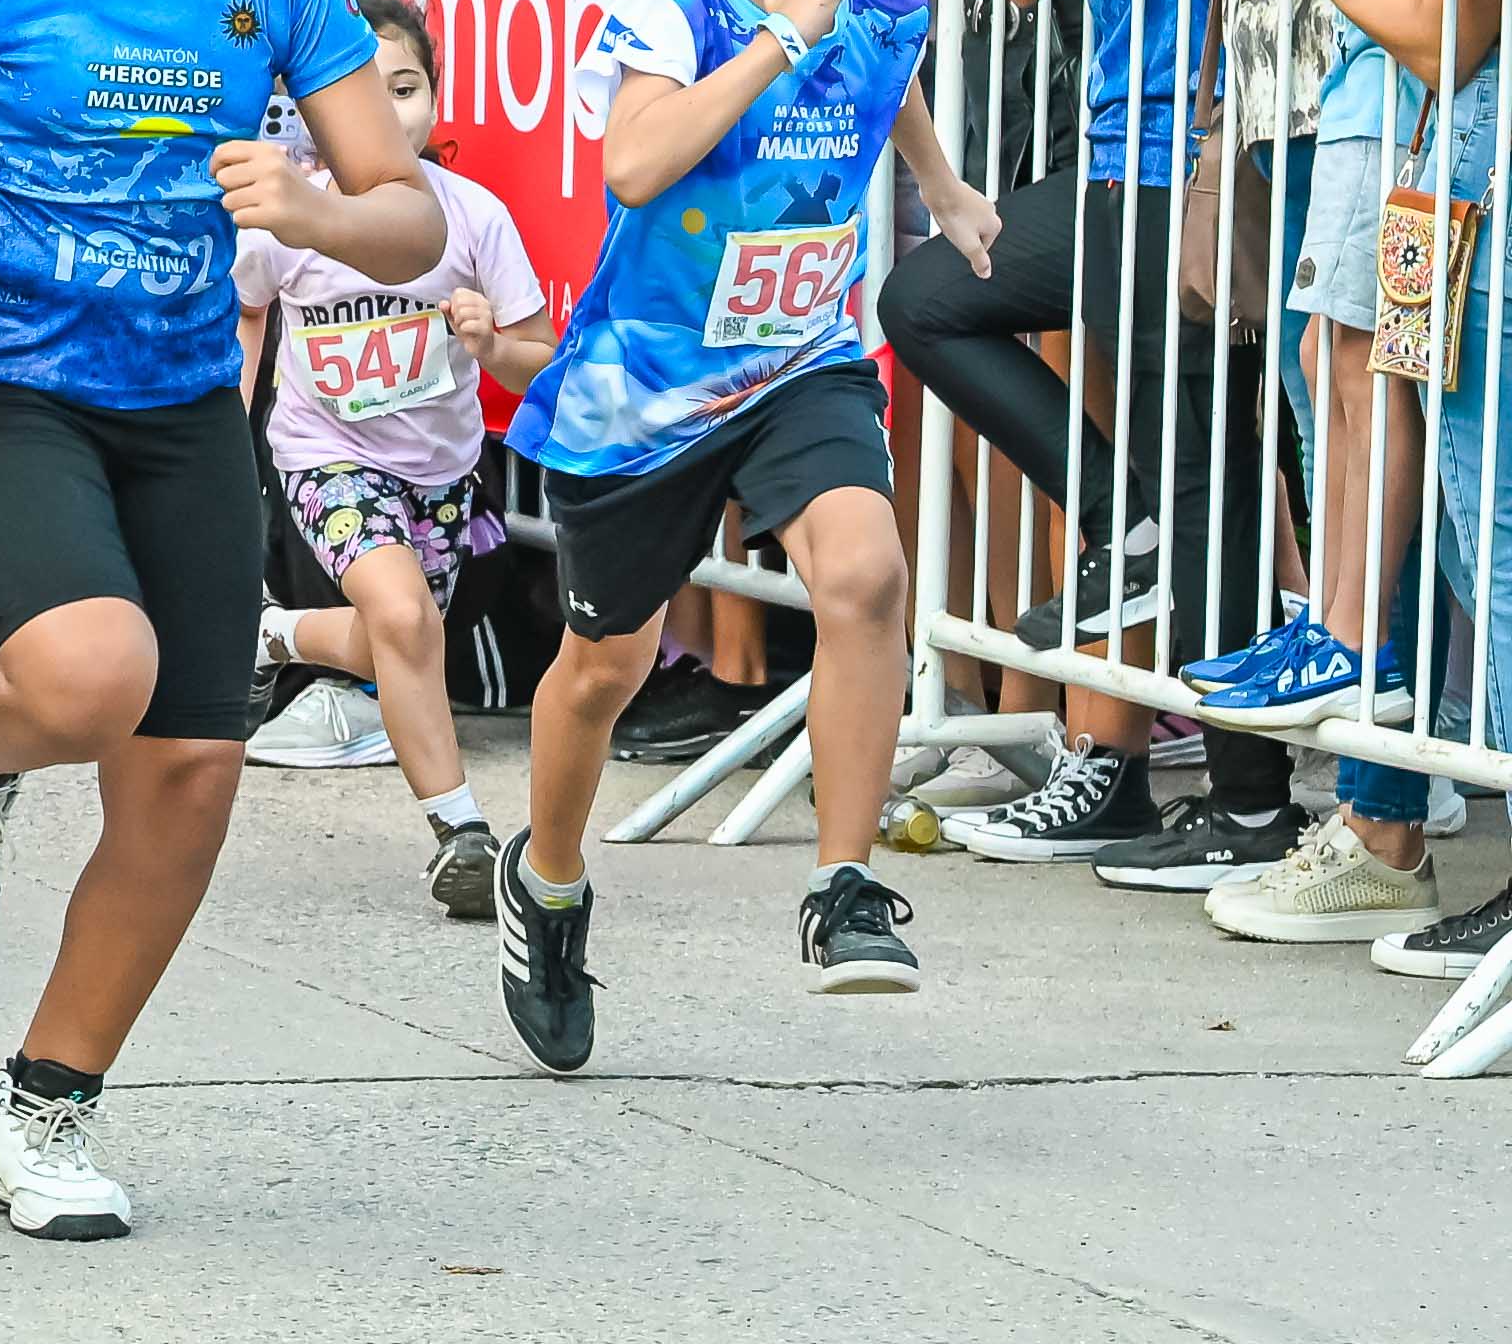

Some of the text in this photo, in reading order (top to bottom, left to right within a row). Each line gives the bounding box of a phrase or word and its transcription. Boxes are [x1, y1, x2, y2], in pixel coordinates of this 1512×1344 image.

[113, 45, 199, 64] MARATÓN
[193, 70, 222, 88] DE
[774, 103, 855, 119] MARATÓN
[839, 118, 855, 131] DE
[756, 133, 860, 160] MALVINAS
[47, 222, 215, 296] 1982
[80, 246, 191, 275] ARGENTINA
[727, 231, 856, 317] 562
[306, 315, 432, 397] 547
[399, 377, 440, 400] CARUSO
[1276, 651, 1353, 694] FILA
[1205, 849, 1234, 863] FILA
